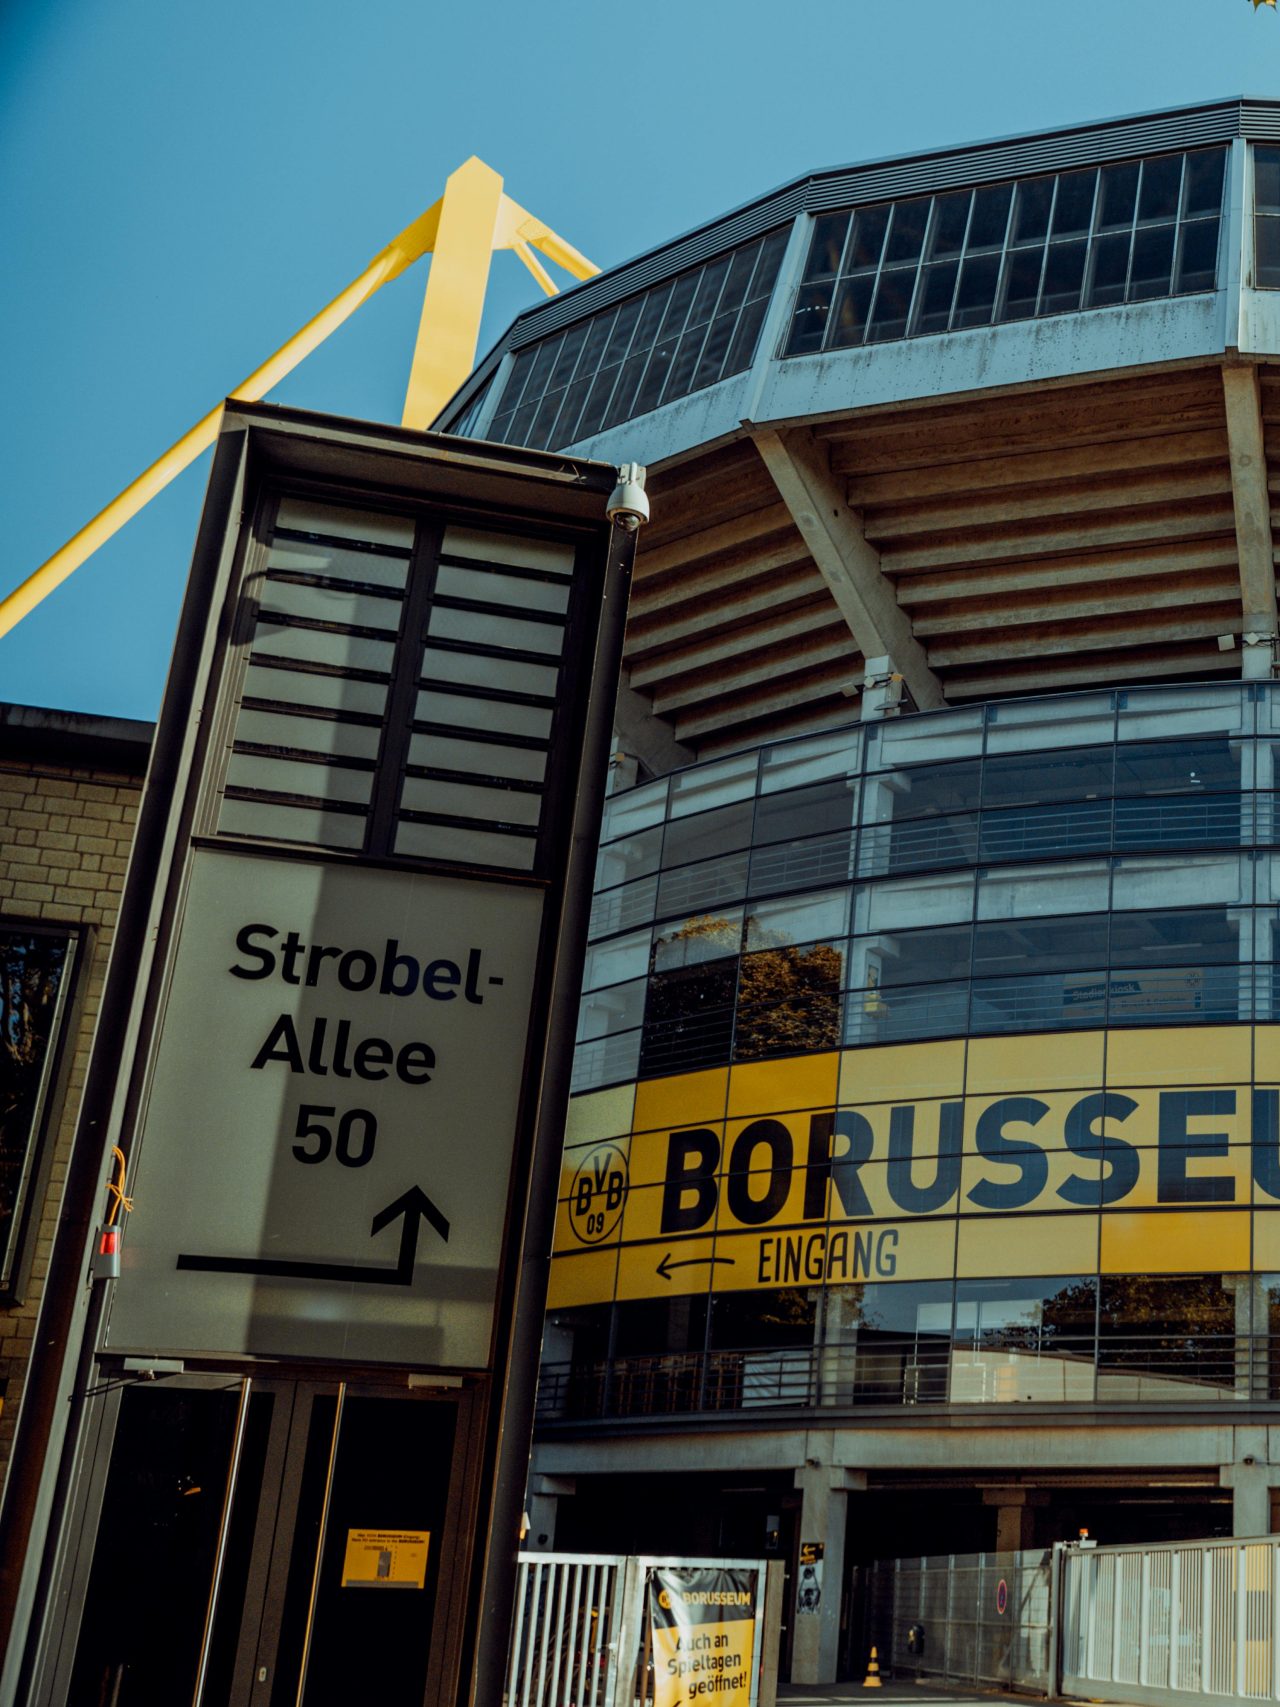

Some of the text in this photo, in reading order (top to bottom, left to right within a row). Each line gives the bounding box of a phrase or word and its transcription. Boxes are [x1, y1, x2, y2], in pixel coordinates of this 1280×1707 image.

[228, 923, 504, 1005] Strobel-
[250, 1013, 437, 1085] Allee
[291, 1104, 378, 1168] 50
[575, 1152, 624, 1217] BVB
[586, 1212, 605, 1235] 09
[757, 1228, 900, 1283] EINGANG
[683, 1591, 751, 1606] BORUSSEUM
[714, 1633, 729, 1648] an
[667, 1653, 742, 1678] Spieltagen
[688, 1671, 747, 1699] geöffnet!
